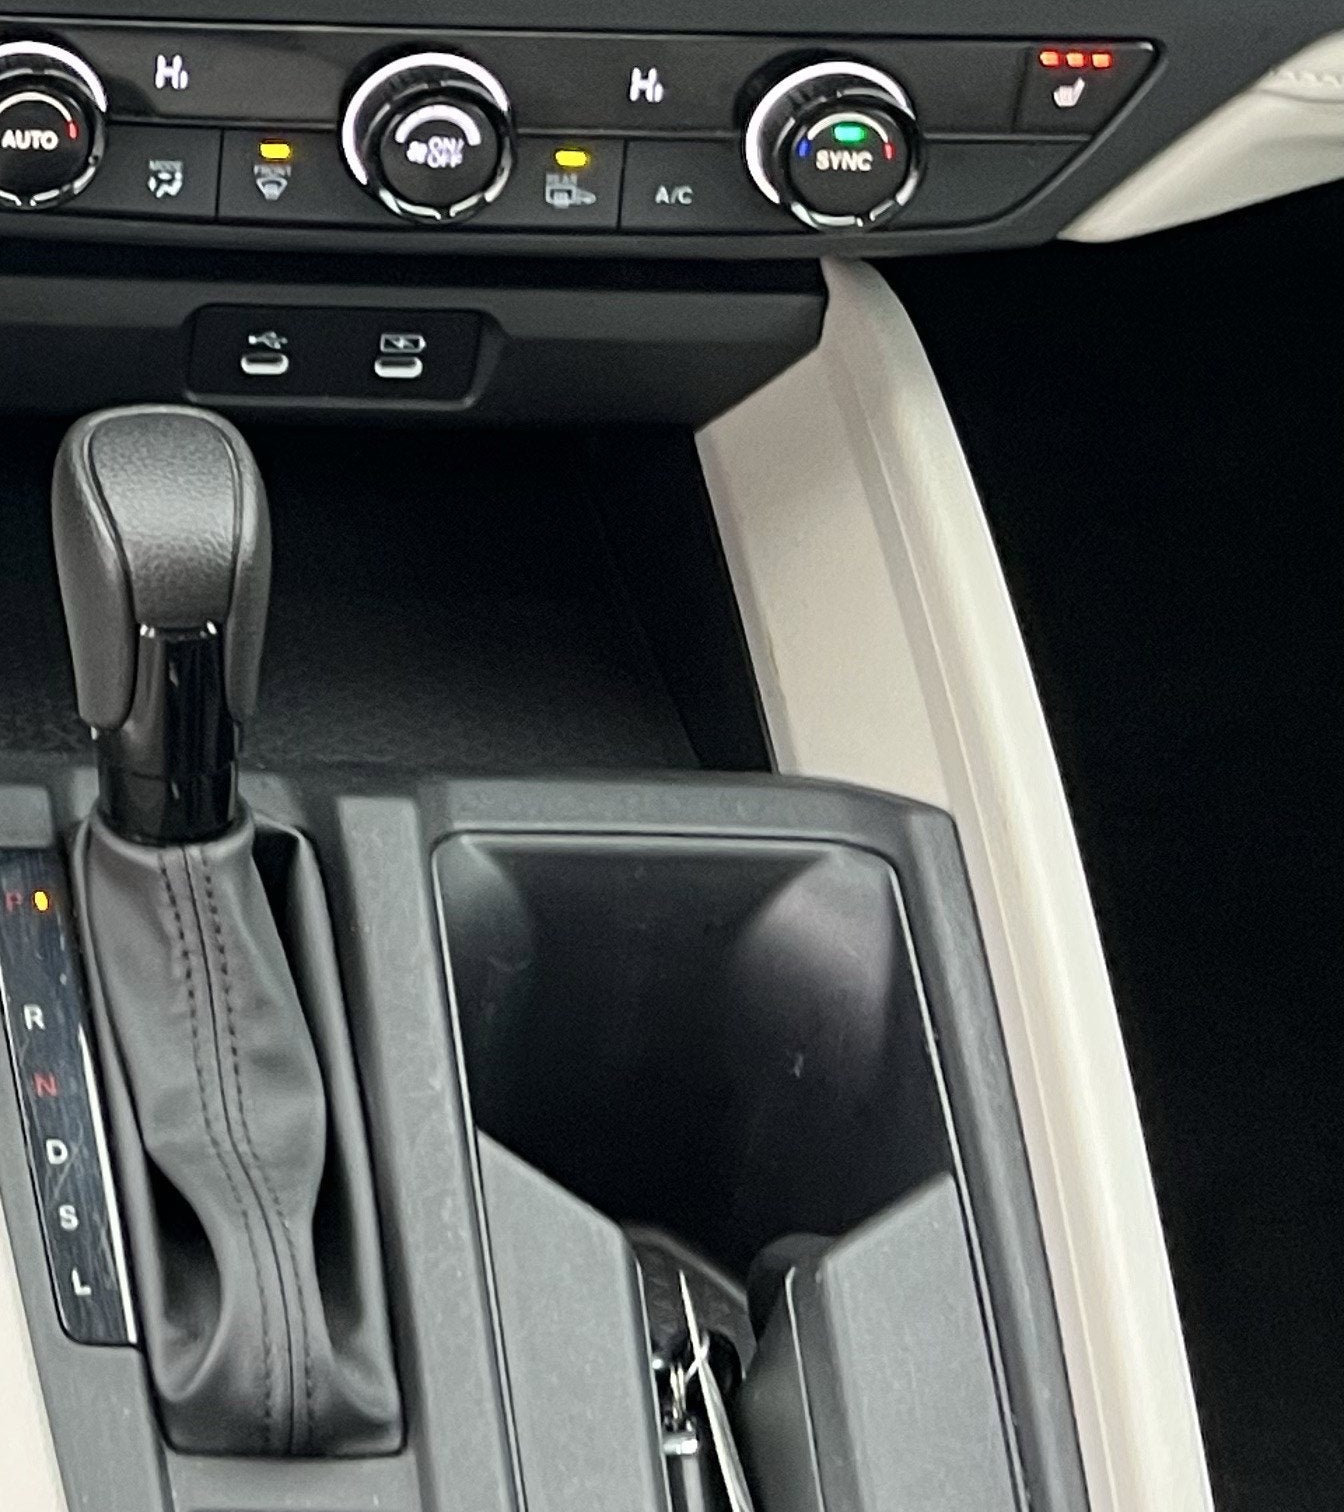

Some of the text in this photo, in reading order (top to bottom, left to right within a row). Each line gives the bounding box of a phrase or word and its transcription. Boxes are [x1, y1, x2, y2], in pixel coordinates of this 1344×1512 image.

[0, 129, 60, 151] AUTO
[815, 148, 874, 172] SYNC
[654, 185, 693, 206] A/C
[5, 891, 23, 910] P
[23, 1004, 46, 1031] R
[34, 1072, 57, 1098] N
[45, 1138, 69, 1165] D
[58, 1204, 80, 1231] S
[71, 1267, 92, 1296] L
